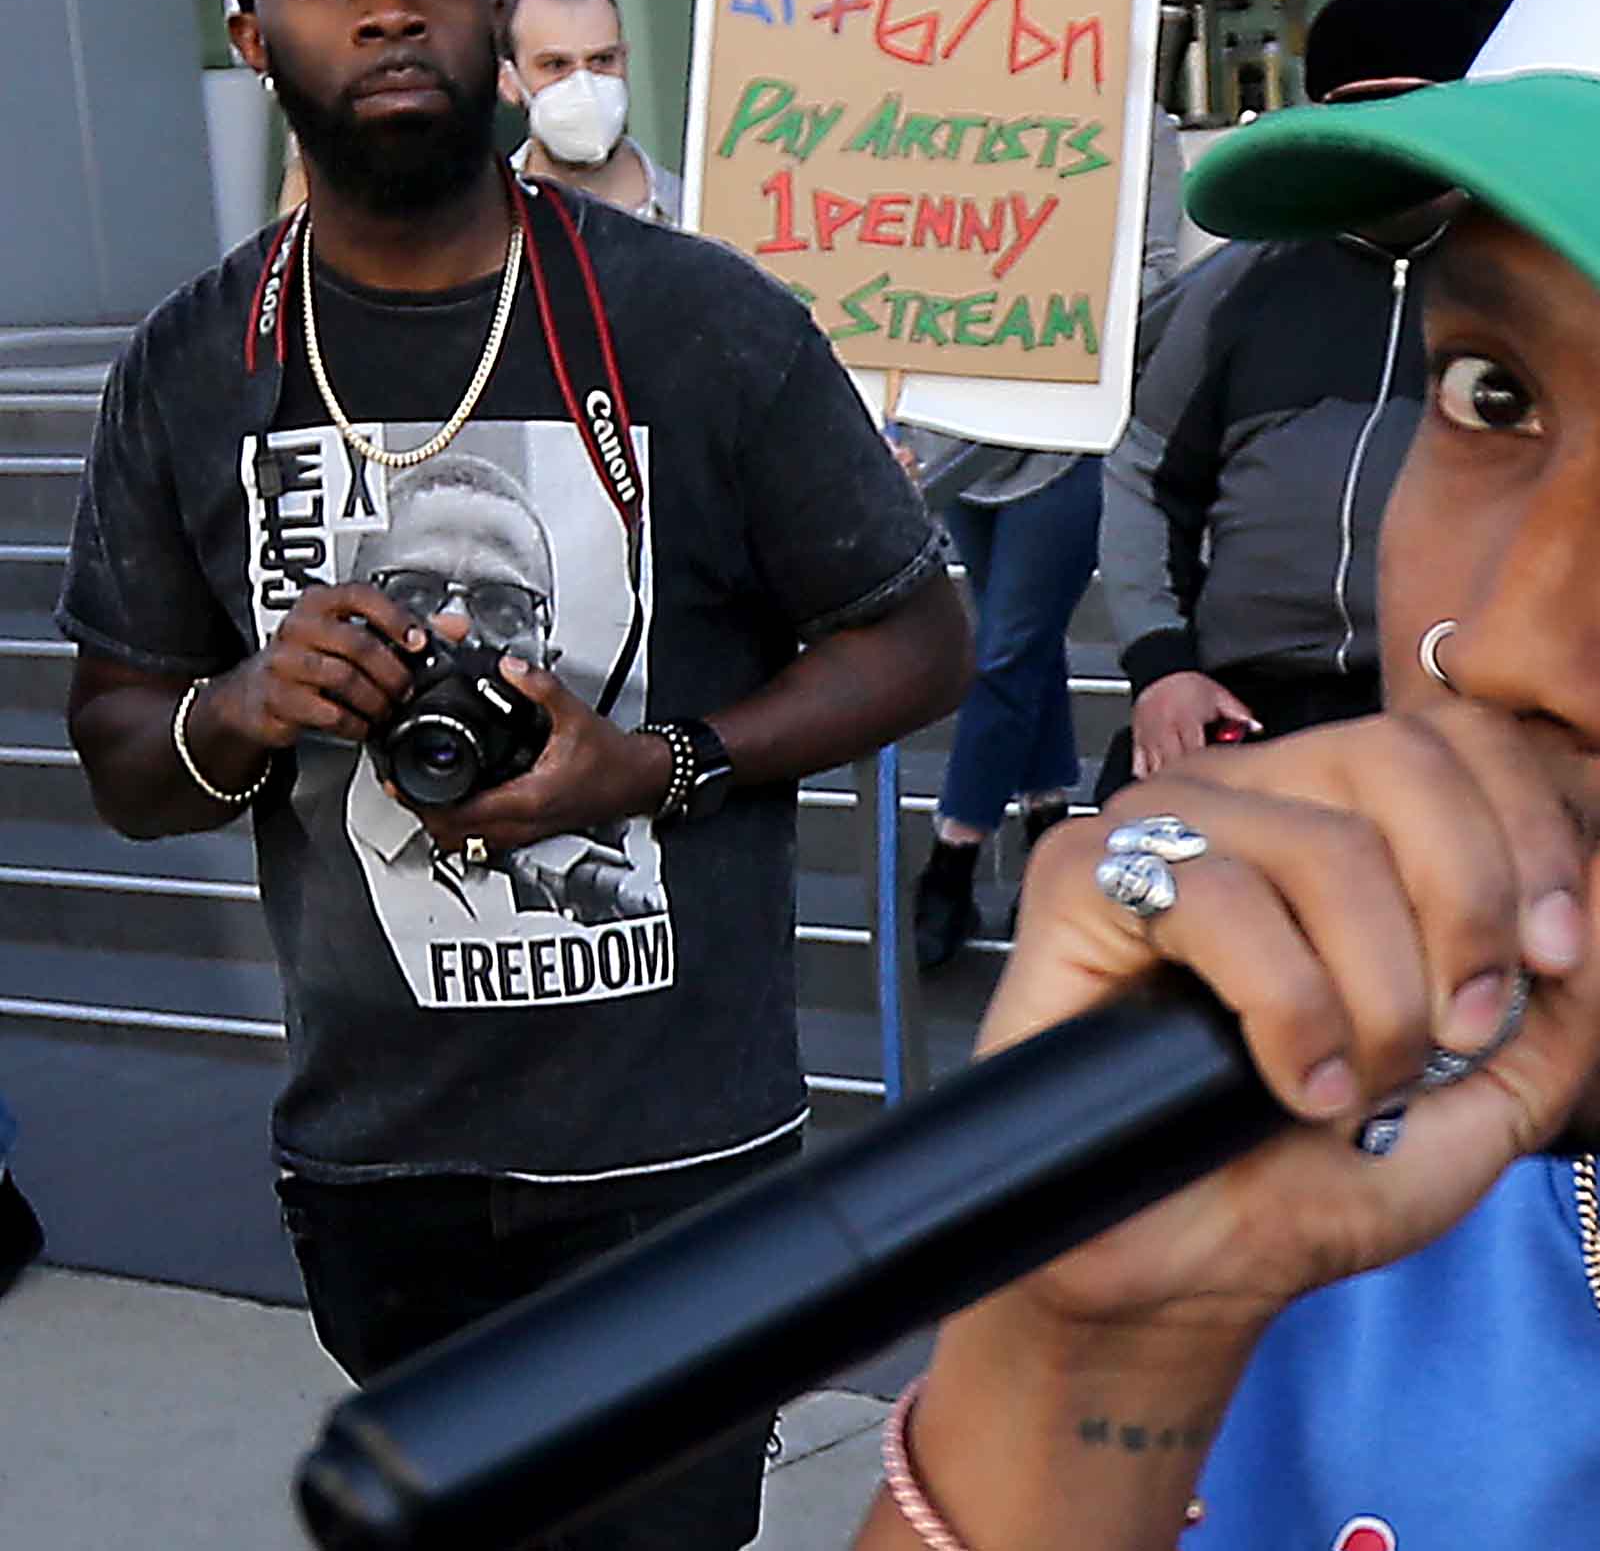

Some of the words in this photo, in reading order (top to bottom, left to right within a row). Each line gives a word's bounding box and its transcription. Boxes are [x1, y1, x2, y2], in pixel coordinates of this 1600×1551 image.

[717, 77, 849, 162] PAY
[843, 92, 1113, 180] ARTISTS
[830, 273, 1100, 354] STREAM
[586, 390, 636, 503] Canon
[429, 921, 670, 1002] FREEDOM
